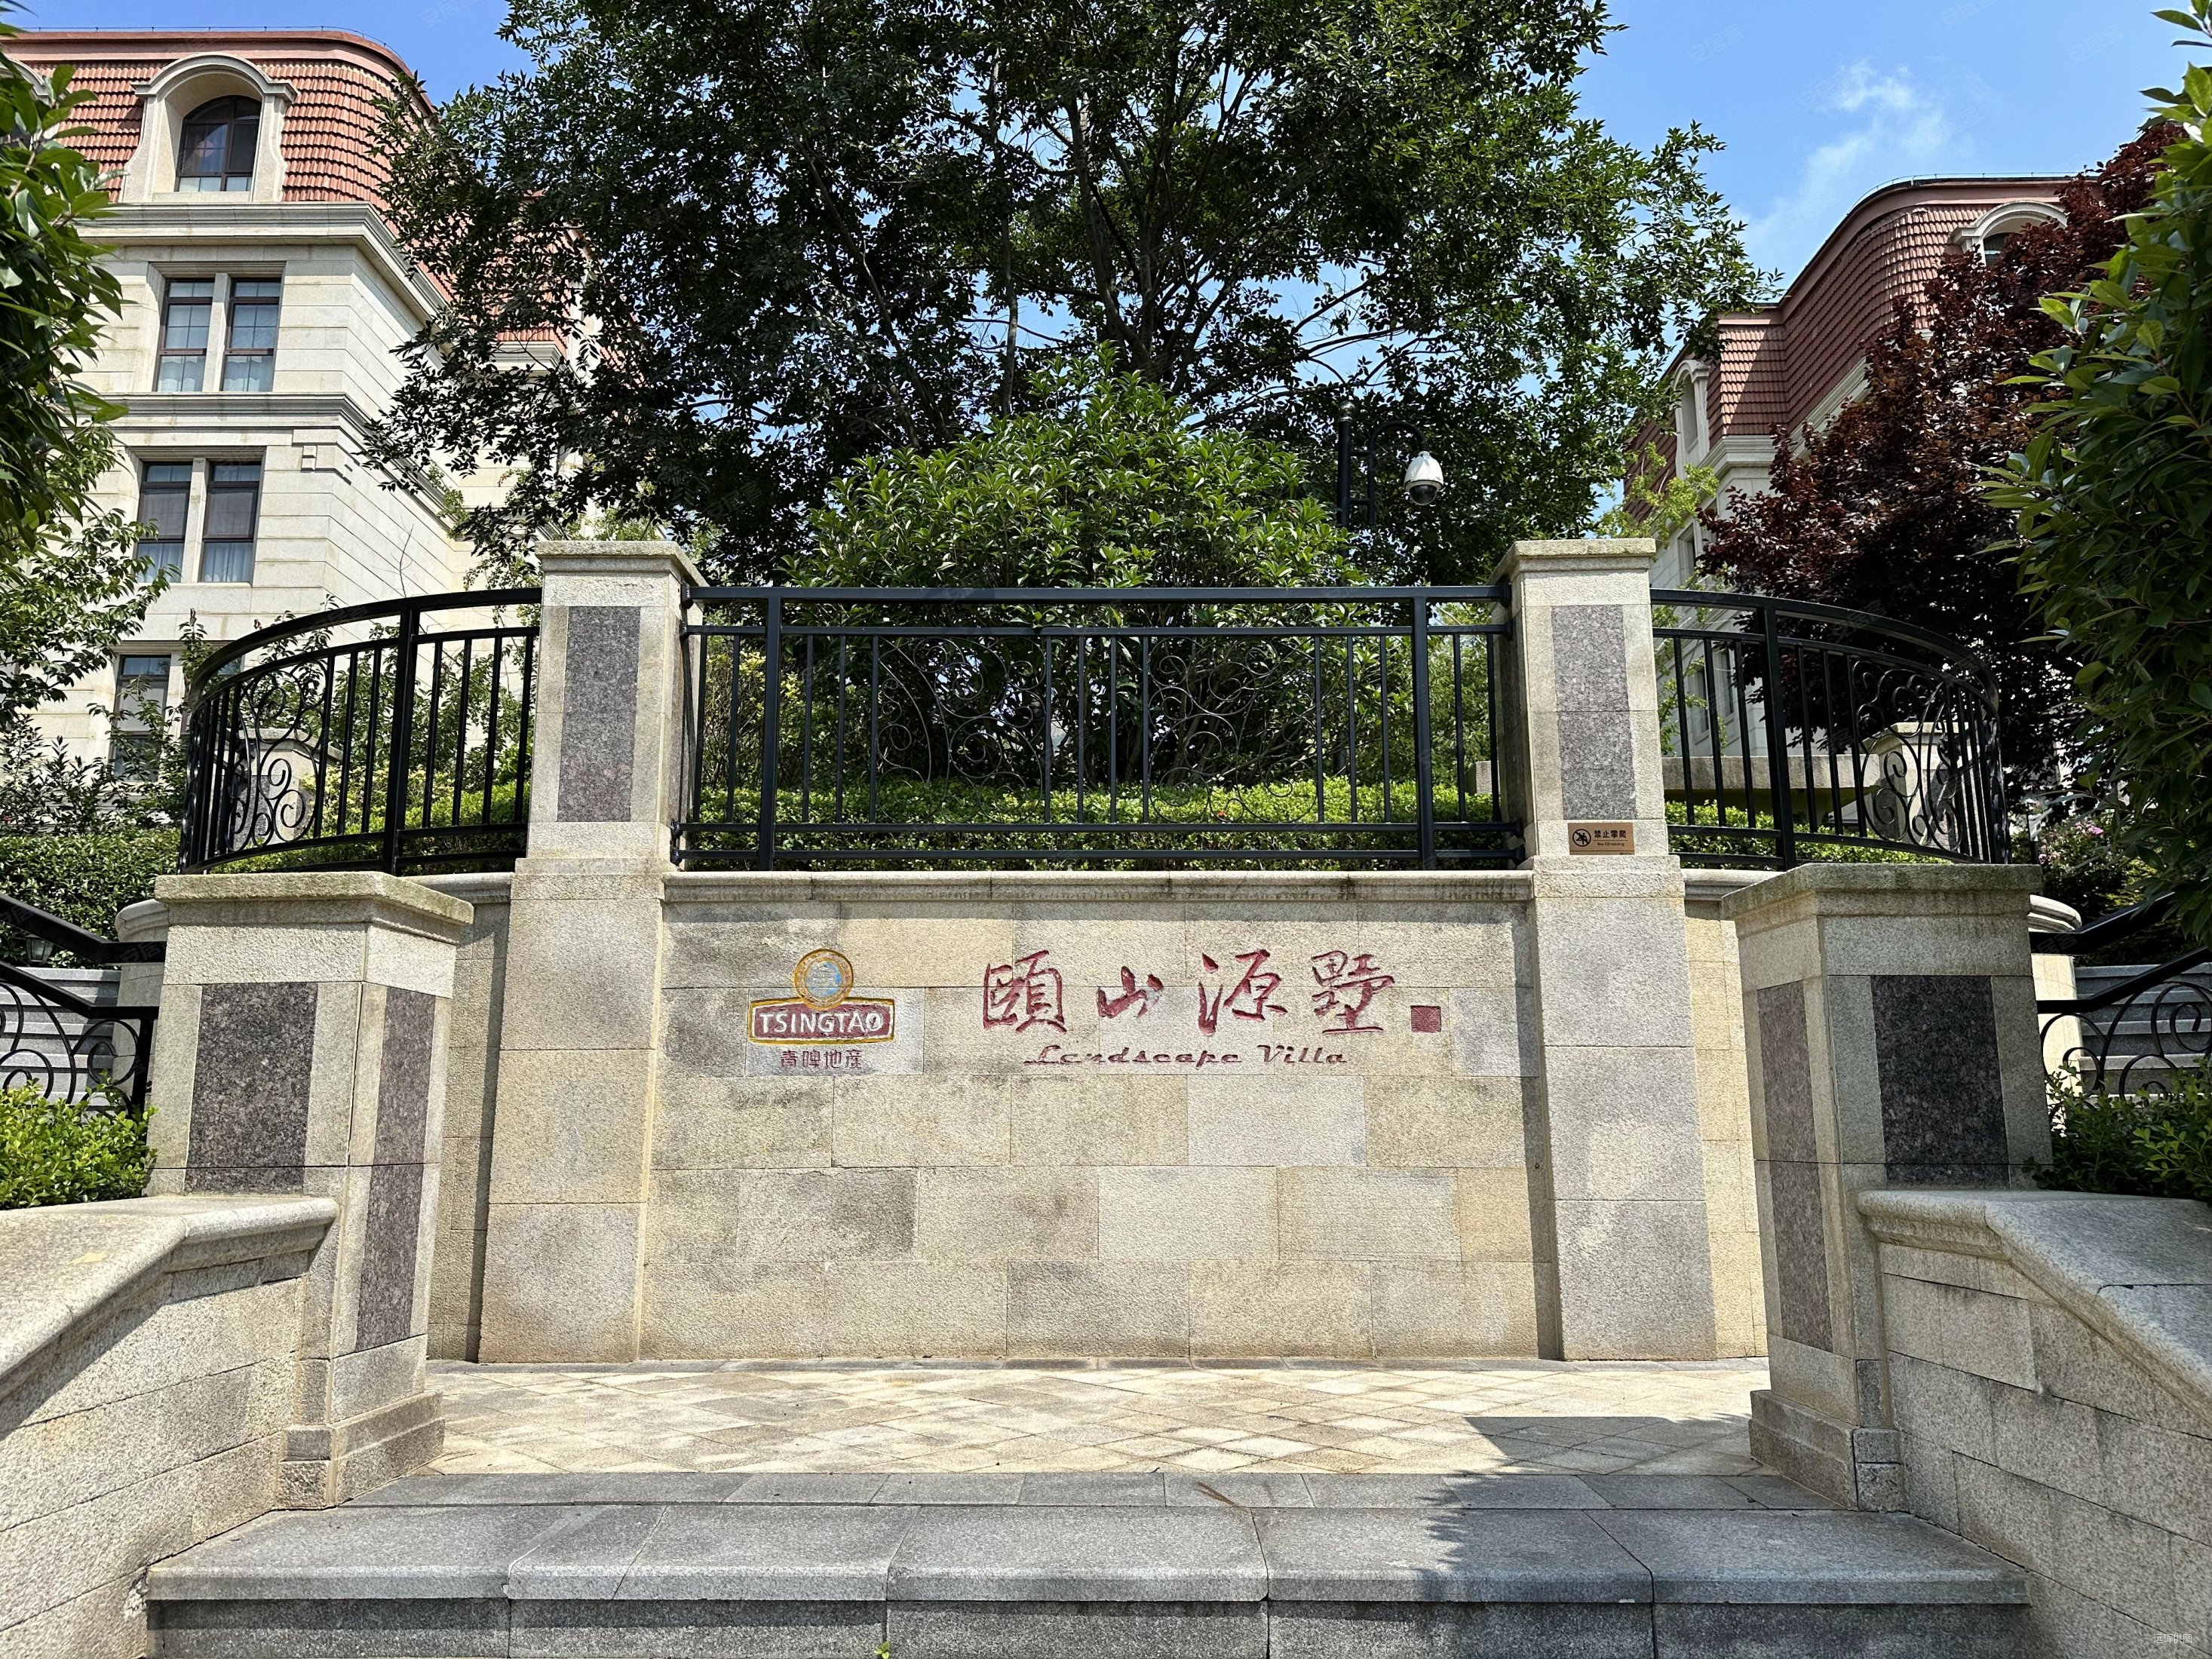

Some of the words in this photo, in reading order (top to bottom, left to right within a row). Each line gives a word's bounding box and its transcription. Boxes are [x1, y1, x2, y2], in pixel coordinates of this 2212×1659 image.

[1594, 830, 1627, 839] 禁止攀爬
[759, 1013, 884, 1034] TSINGTAO
[1256, 1044, 1348, 1064] Villa
